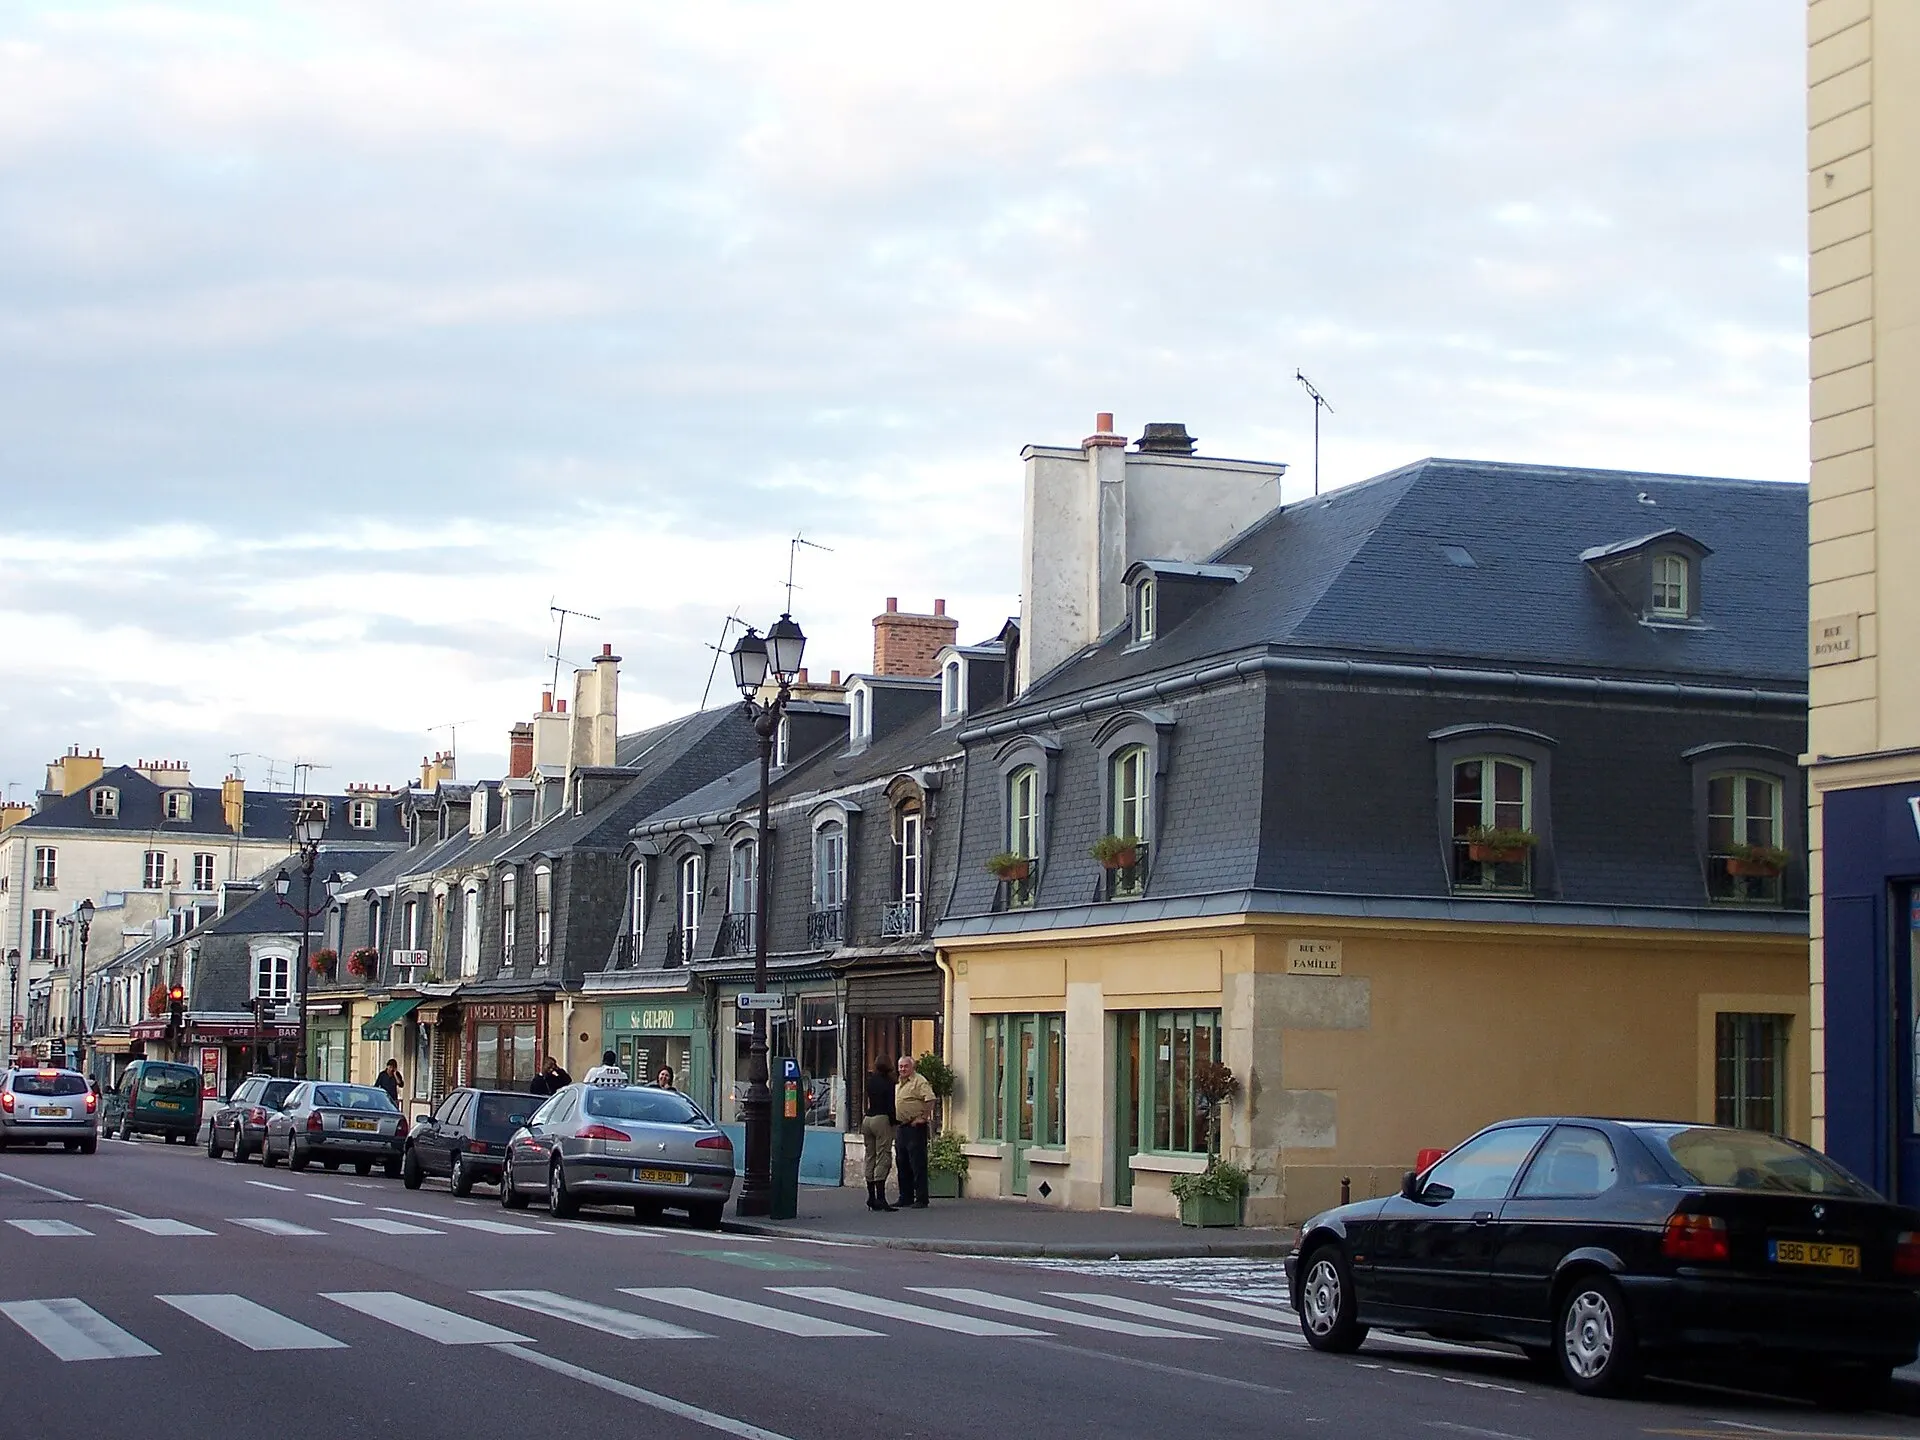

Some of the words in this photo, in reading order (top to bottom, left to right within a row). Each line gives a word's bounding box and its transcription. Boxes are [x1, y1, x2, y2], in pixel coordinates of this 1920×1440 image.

[1823, 626, 1841, 638] RUE
[1815, 640, 1851, 655] ROYALE
[1299, 944, 1315, 953] RUE
[394, 951, 427, 965] LEURS
[1293, 958, 1337, 970] FAMILLE
[470, 1004, 537, 1019] IMPRIMERIE
[278, 1028, 297, 1037] BAR
[784, 1060, 795, 1077] P
[1778, 1243, 1804, 1261] 586
[1809, 1245, 1833, 1263] CKF
[1838, 1247, 1855, 1265] 78
